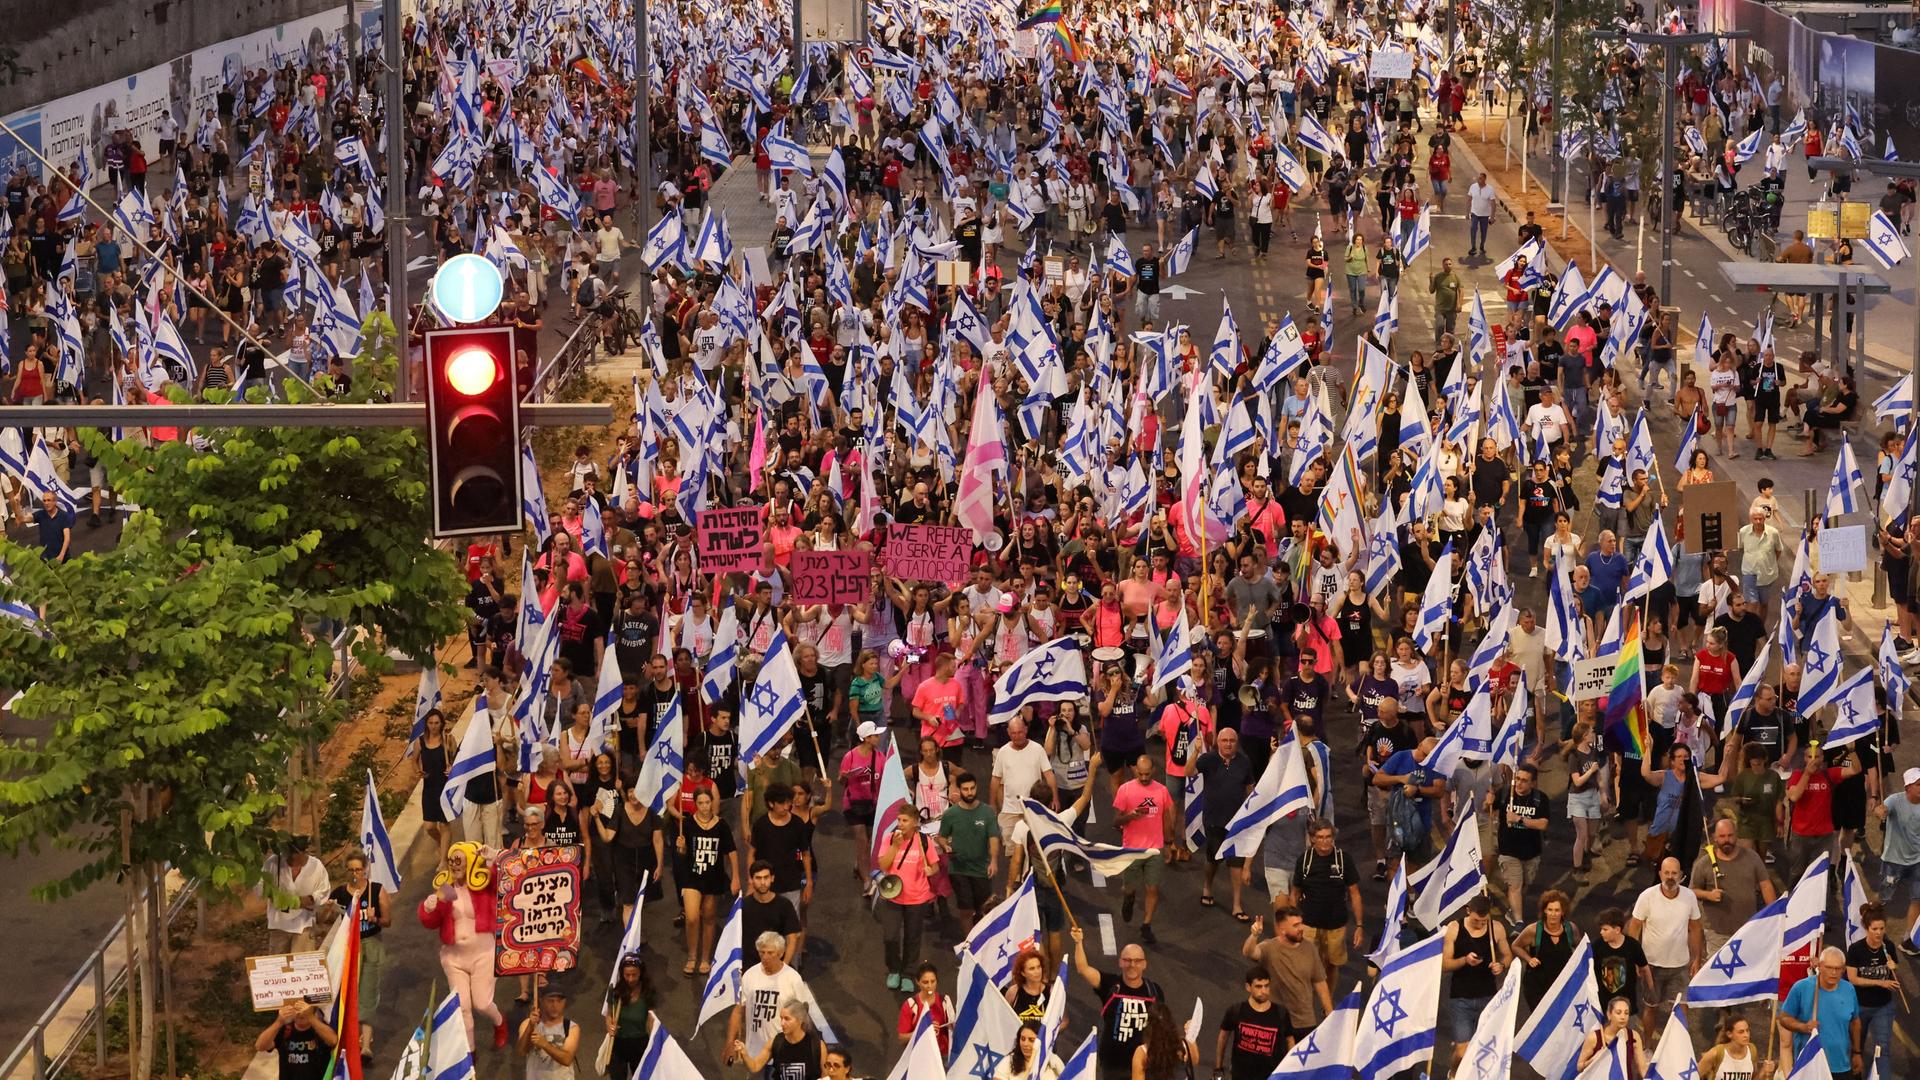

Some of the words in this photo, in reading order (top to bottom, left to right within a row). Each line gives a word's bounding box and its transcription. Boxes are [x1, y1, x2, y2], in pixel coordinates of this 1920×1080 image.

[703, 511, 760, 530] מסרבות
[707, 529, 761, 551] לשרת
[890, 524, 920, 542] WE
[927, 527, 974, 547] REFUSE
[889, 542, 904, 556] TO
[907, 544, 948, 559] SERVE
[951, 546, 965, 561] A
[701, 553, 762, 568] דיקטטורה
[801, 556, 830, 572] מתי
[834, 556, 862, 571] עד
[885, 559, 972, 581] DICTATORSHIP
[831, 570, 870, 605] קפלן
[1579, 680, 1605, 691] קרטיה
[712, 745, 733, 756] דמו
[698, 837, 720, 850] דמו
[696, 850, 720, 866] קרט
[524, 877, 570, 896] מצילים
[533, 894, 557, 906] את
[520, 922, 566, 942] קרטיה!
[255, 991, 275, 1001] לאמץ
[756, 990, 780, 1005] דמו
[753, 1004, 778, 1022] קרט
[1122, 999, 1147, 1014] דמו
[753, 1019, 763, 1033] יה
[1120, 1013, 1149, 1032] קרט
[1118, 1028, 1134, 1043] יה
